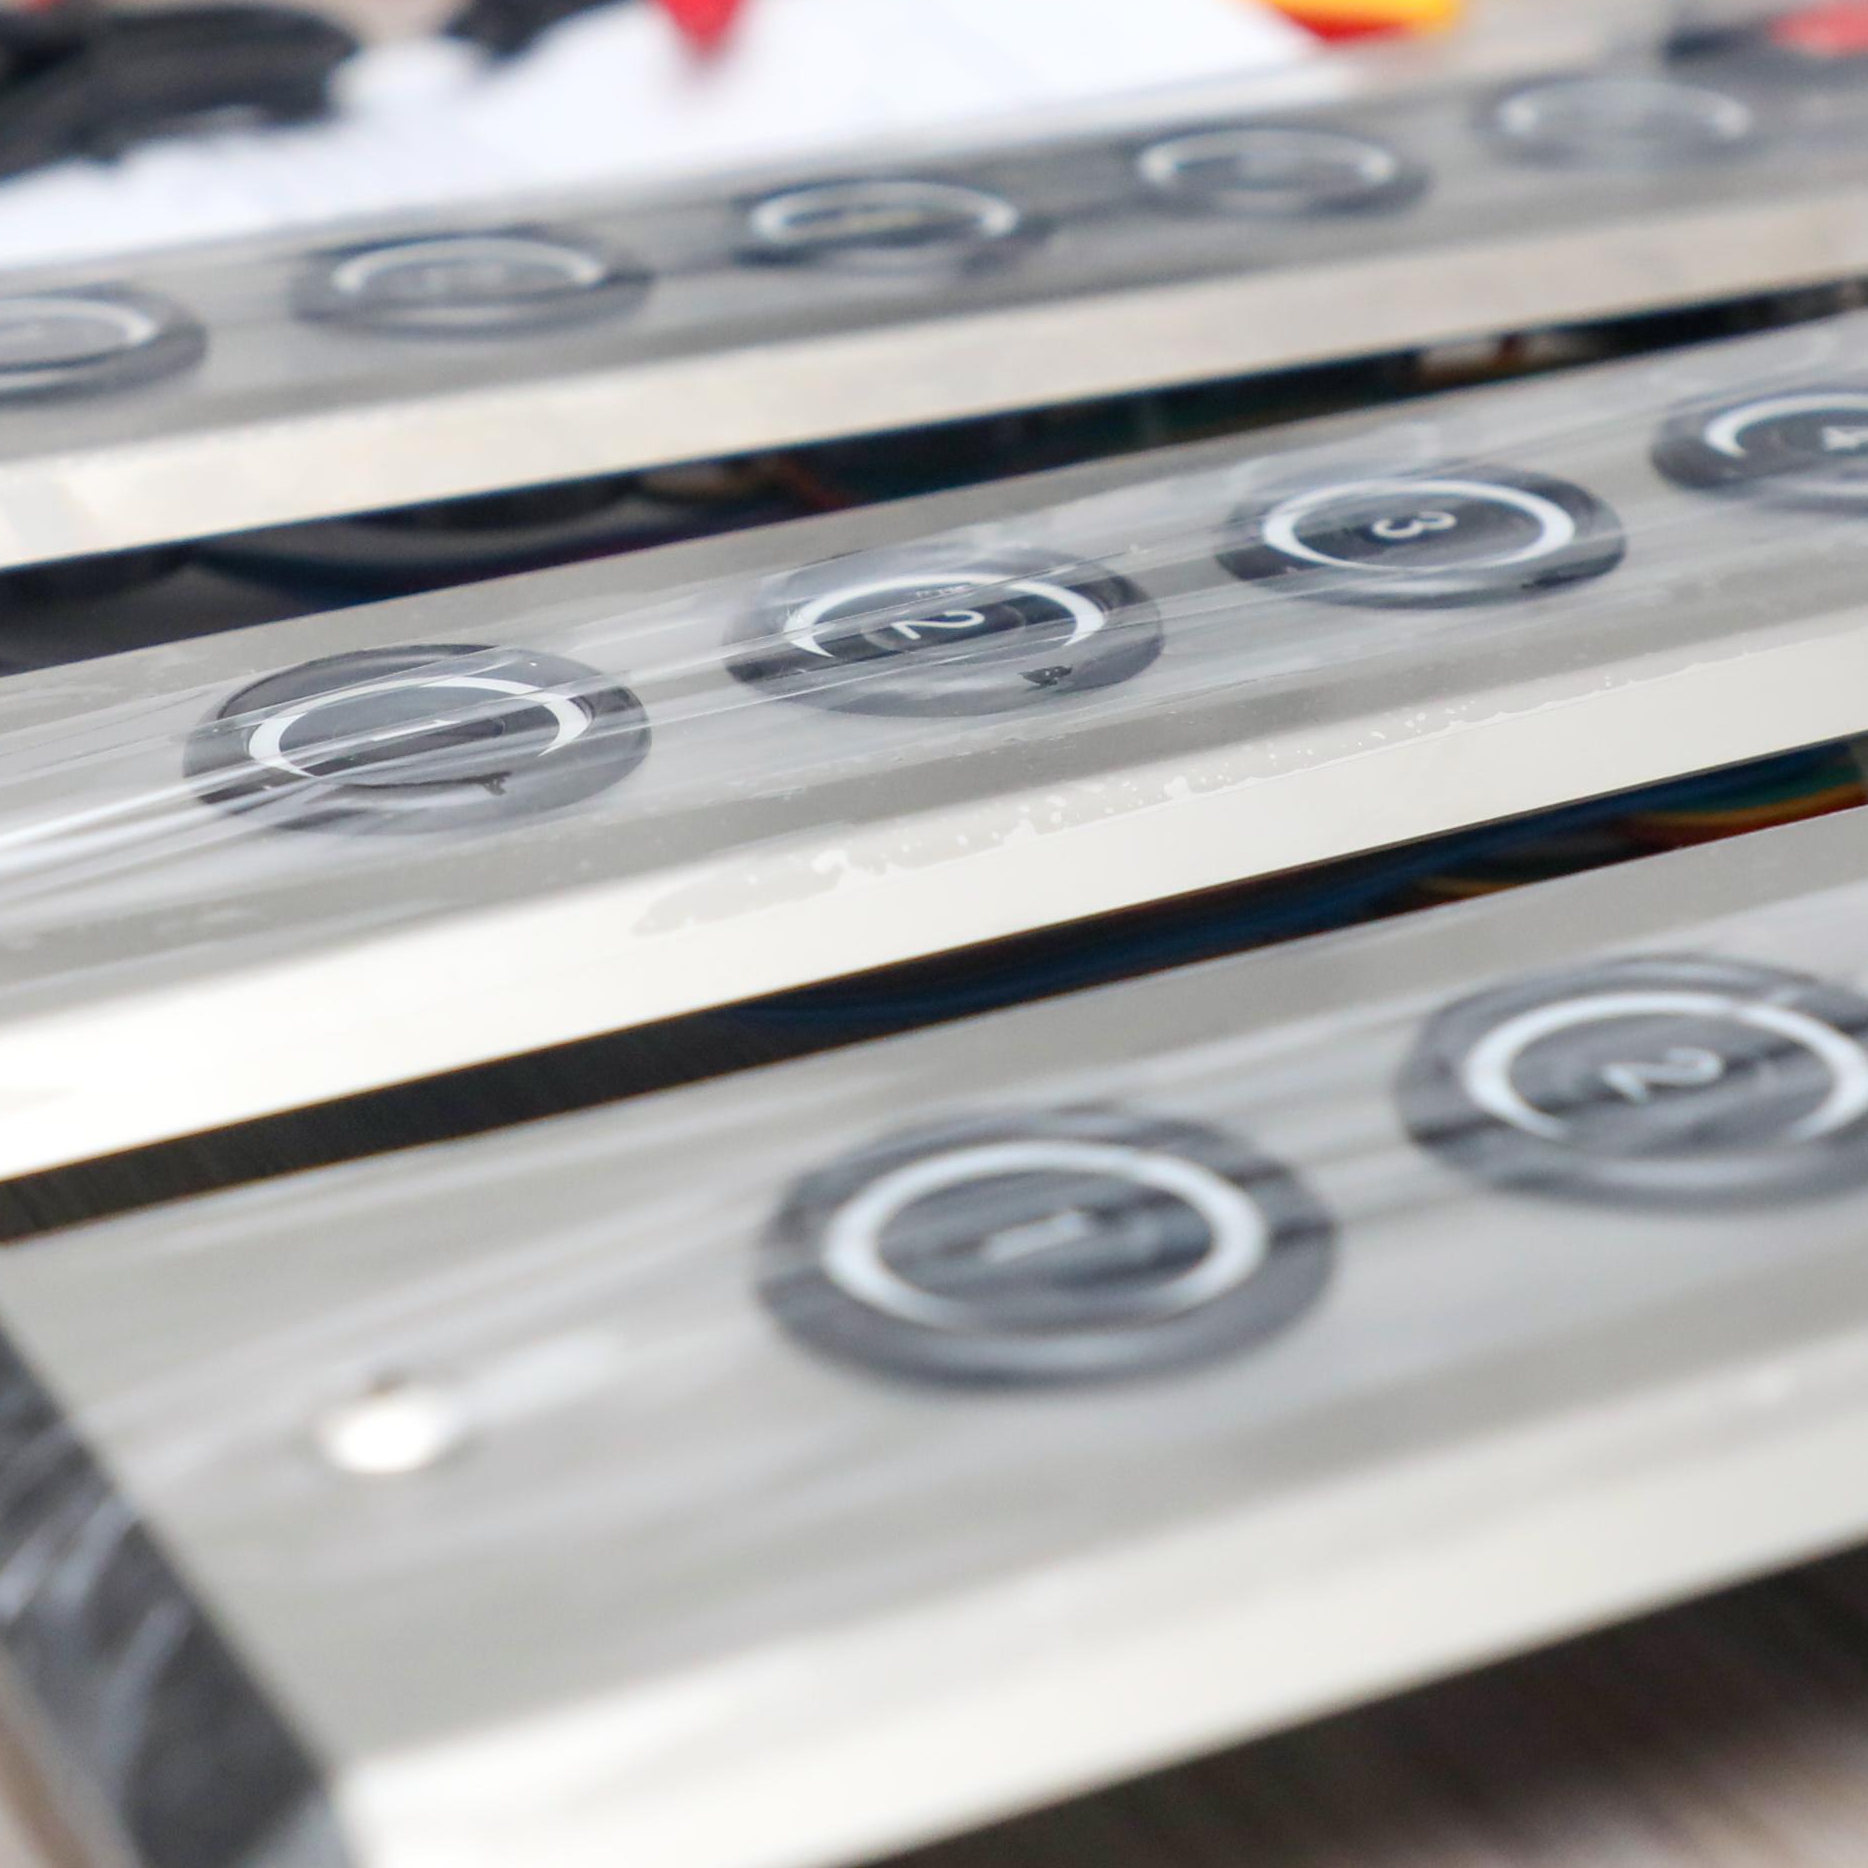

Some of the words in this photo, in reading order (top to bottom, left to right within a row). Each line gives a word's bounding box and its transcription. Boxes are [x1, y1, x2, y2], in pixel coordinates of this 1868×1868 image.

[1372, 510, 1458, 539] 3
[890, 609, 986, 640] 2
[1603, 1045, 1725, 1102] 2
